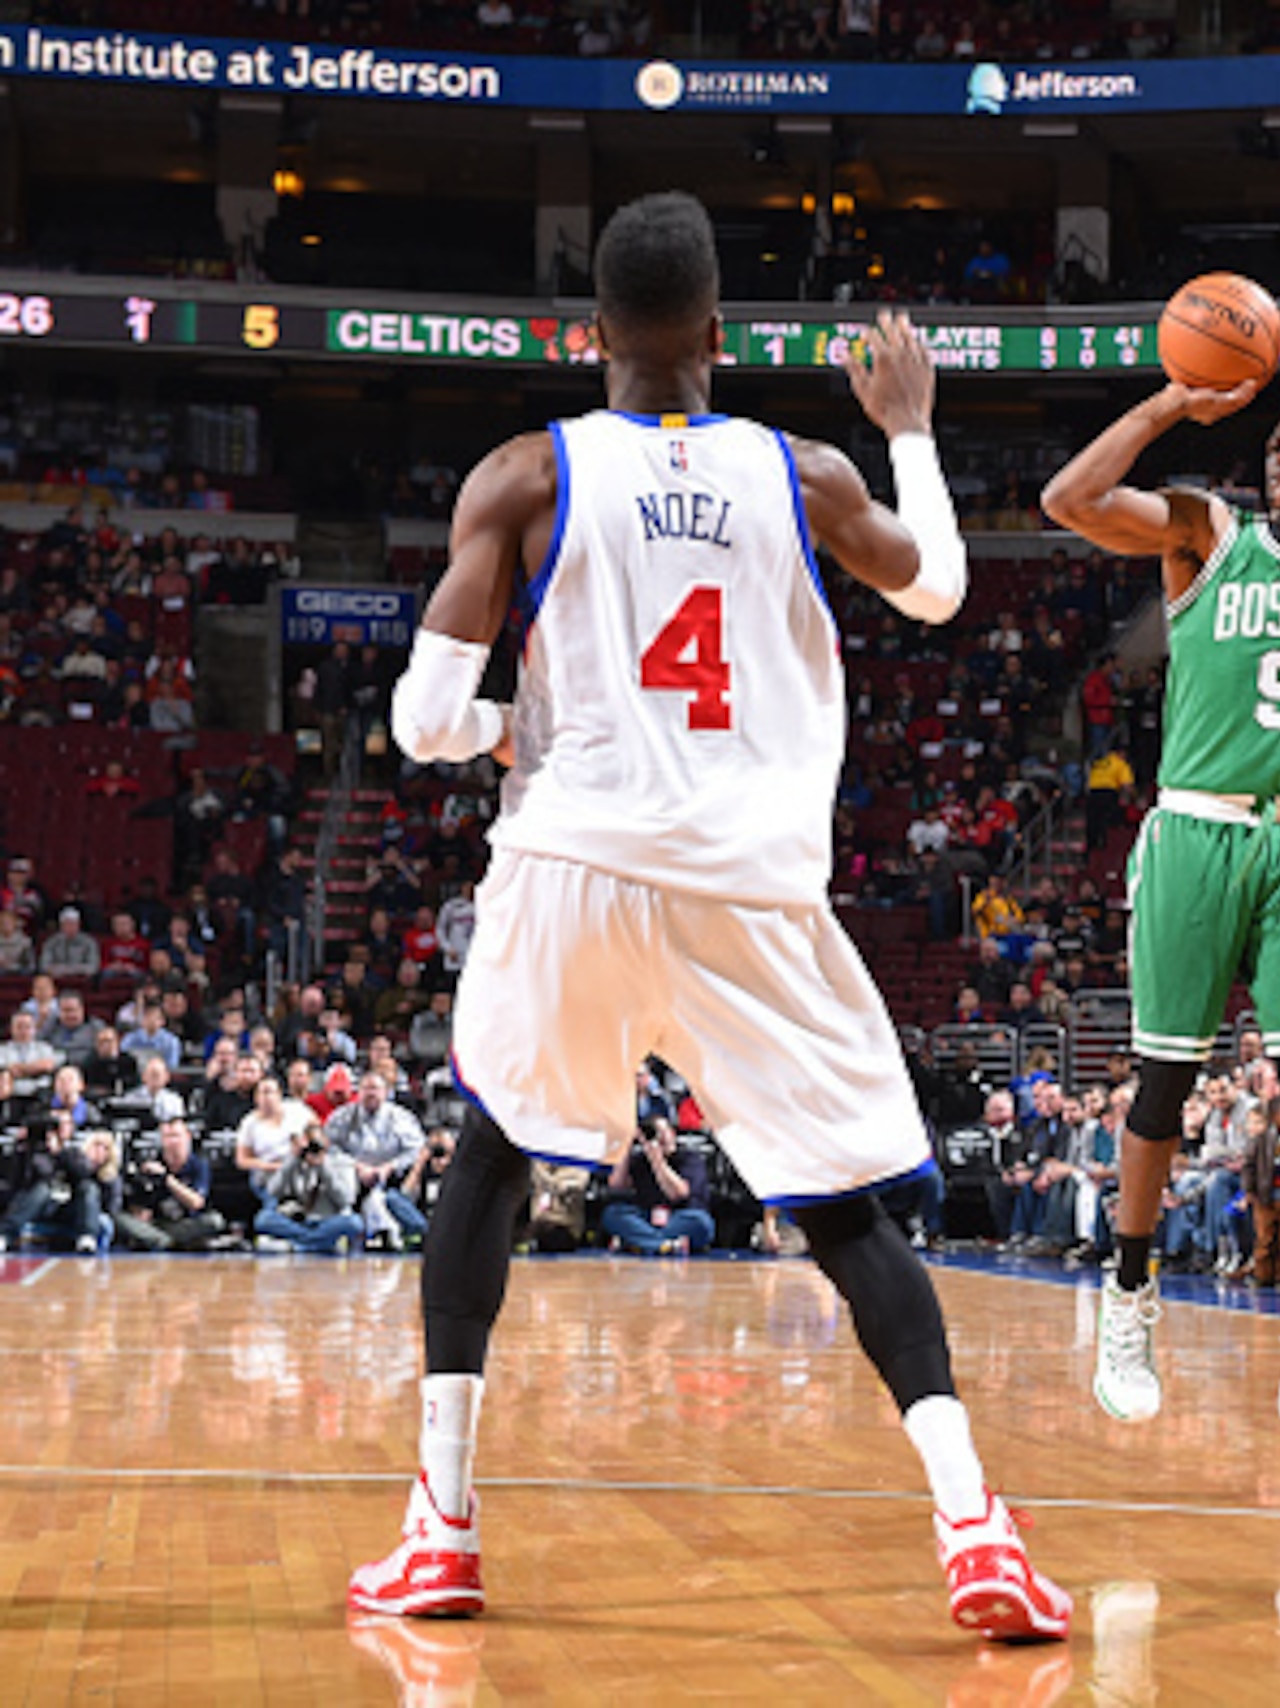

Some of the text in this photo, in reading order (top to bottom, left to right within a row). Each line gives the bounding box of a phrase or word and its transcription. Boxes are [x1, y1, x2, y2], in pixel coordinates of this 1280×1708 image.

[26, 27, 217, 81] Institute
[226, 45, 274, 85] at
[282, 45, 500, 98] Jefferson
[685, 71, 830, 94] ROTHMAN
[1011, 70, 1137, 100] Jefferson
[242, 304, 280, 350] 5
[337, 309, 521, 357] CELTICS
[1078, 326, 1097, 347] 7
[764, 336, 785, 366] 1
[636, 493, 732, 549] NOEL
[639, 584, 733, 731] 4
